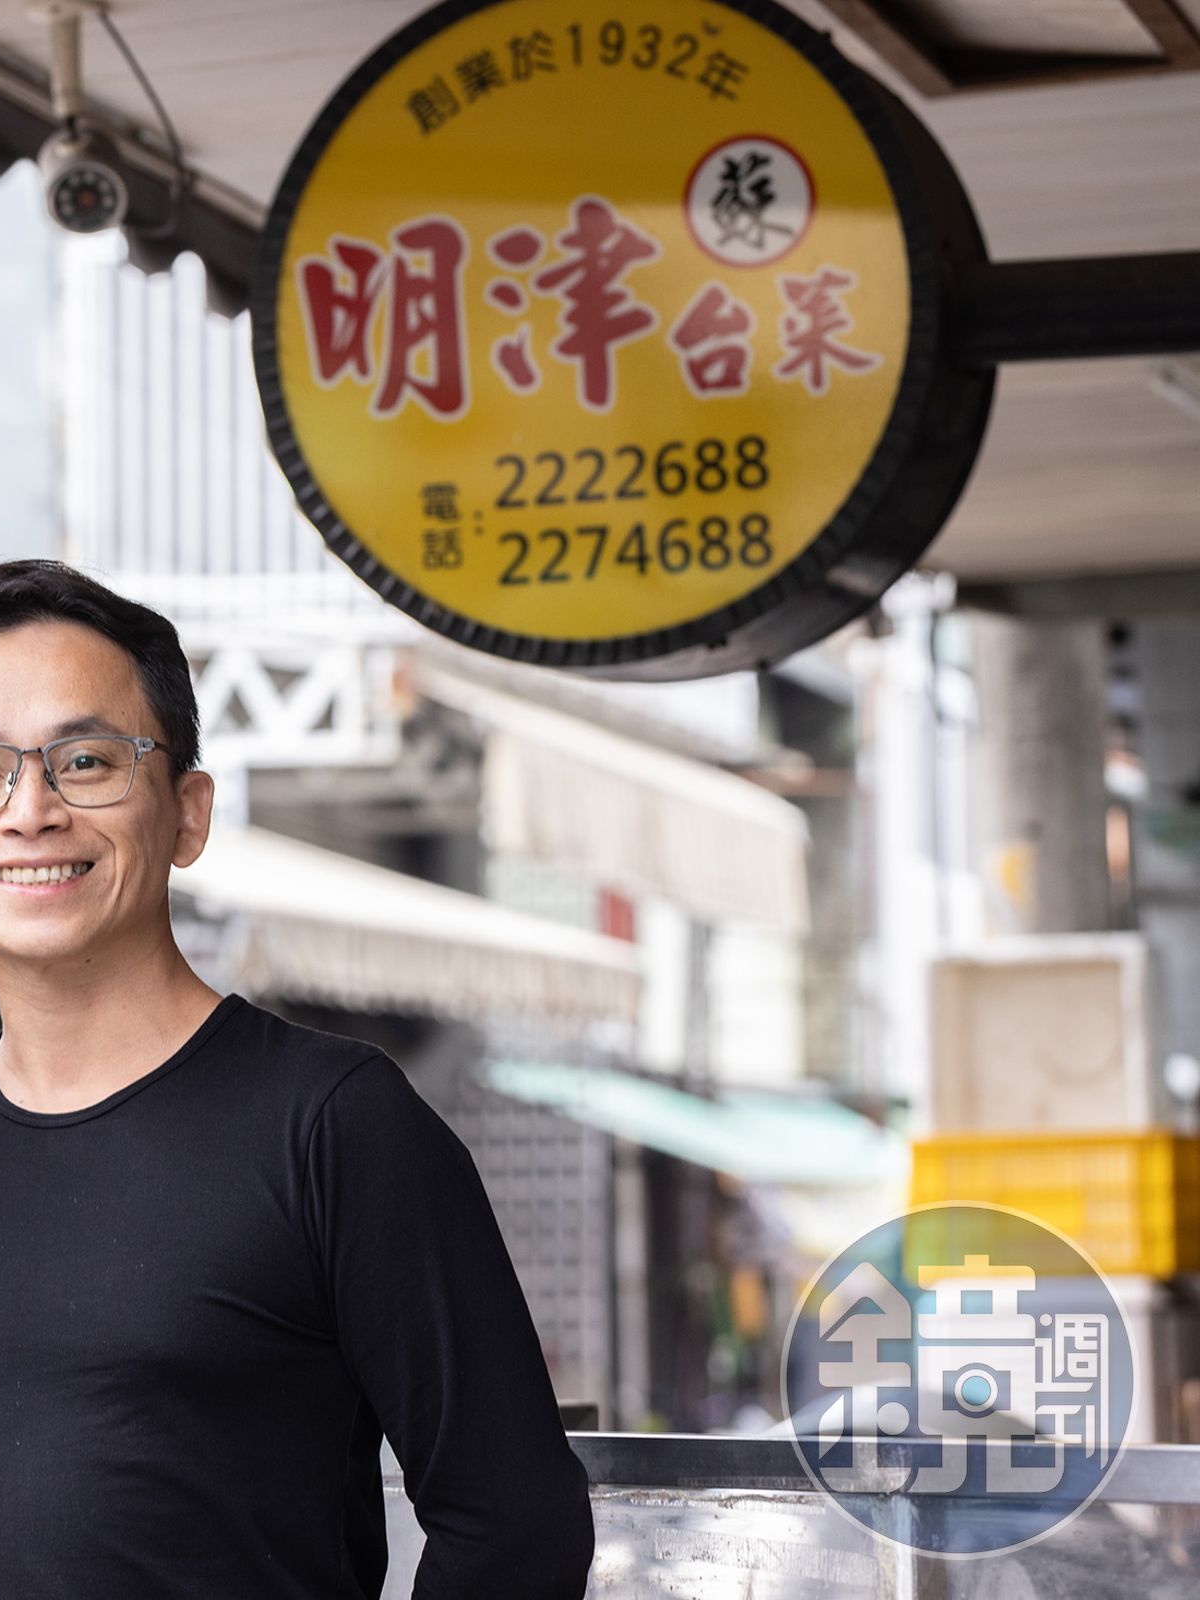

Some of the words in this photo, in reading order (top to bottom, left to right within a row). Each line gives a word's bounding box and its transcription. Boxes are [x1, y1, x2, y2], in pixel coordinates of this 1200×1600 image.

[407, 20, 752, 137] 創業於1932年
[709, 150, 792, 251] 蘇
[494, 435, 770, 510] 2222688
[498, 513, 774, 587] 2274688
